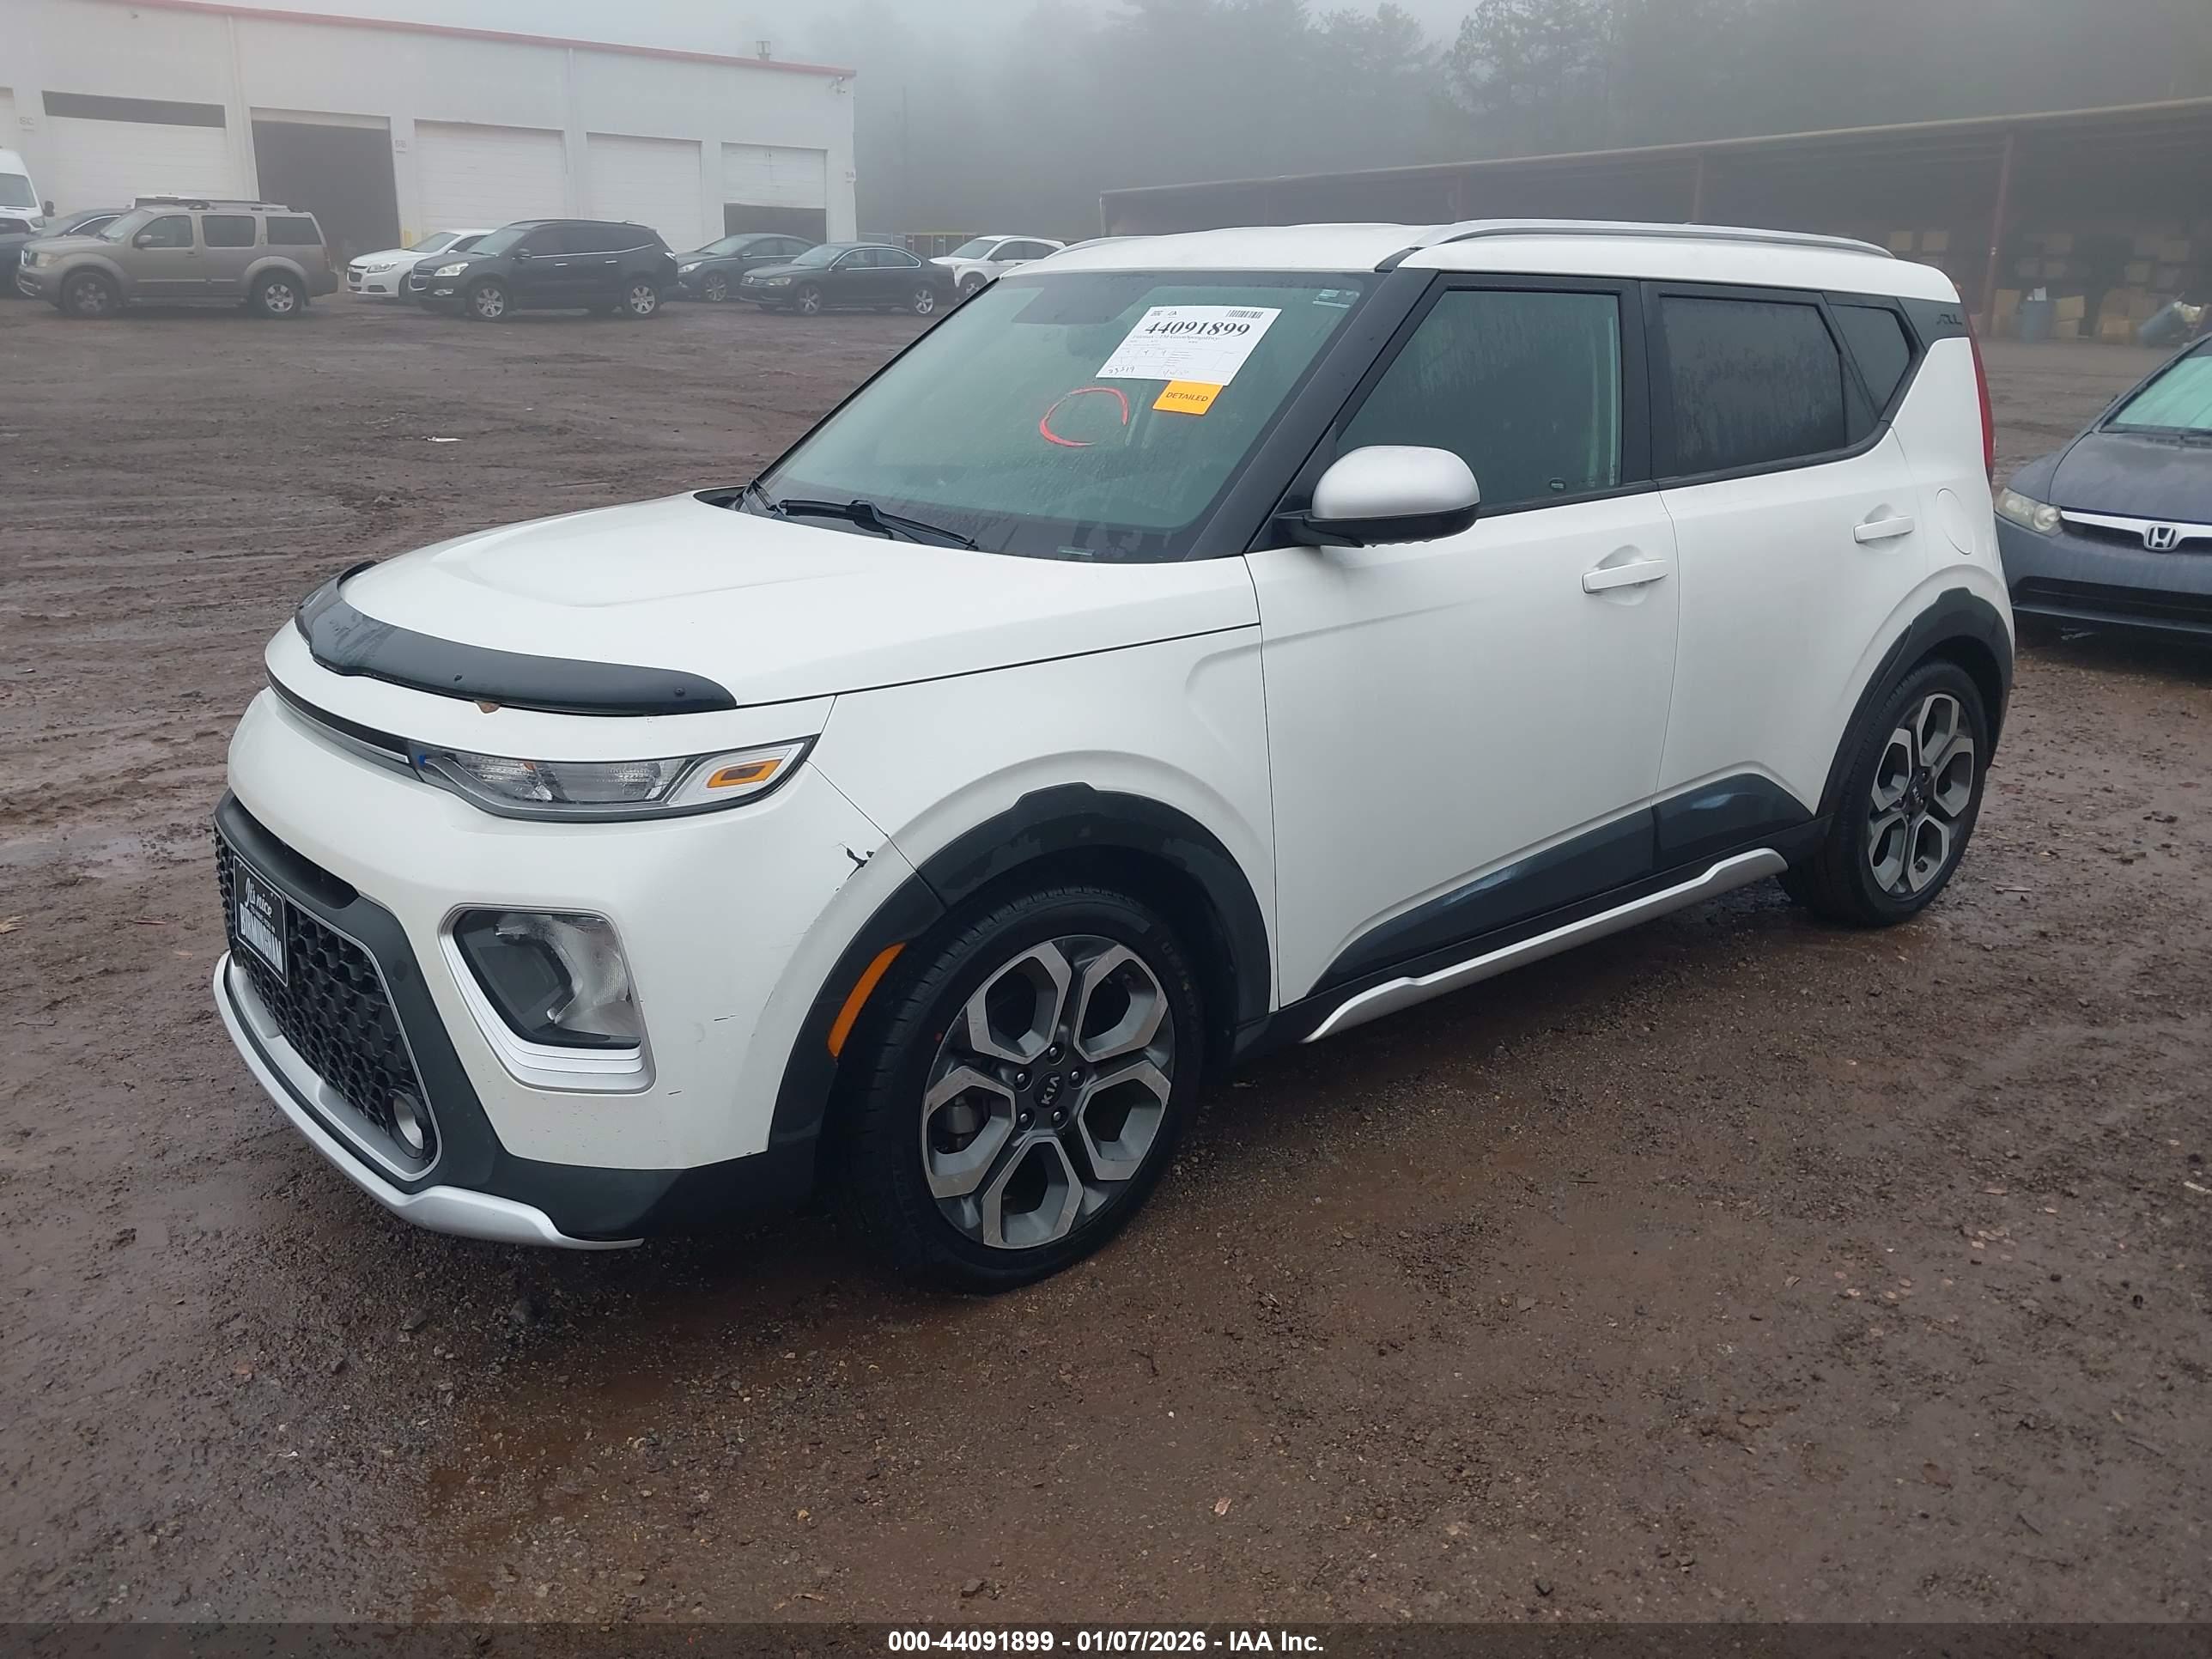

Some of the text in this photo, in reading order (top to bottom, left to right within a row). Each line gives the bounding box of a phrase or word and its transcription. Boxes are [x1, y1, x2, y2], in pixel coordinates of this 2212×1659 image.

[1145, 321, 1250, 337] 44091899
[1165, 392, 1208, 403] DETAILED
[257, 894, 272, 918] nice
[240, 902, 283, 975] BIRMINGHAM
[1041, 1076, 1060, 1105] KIA
